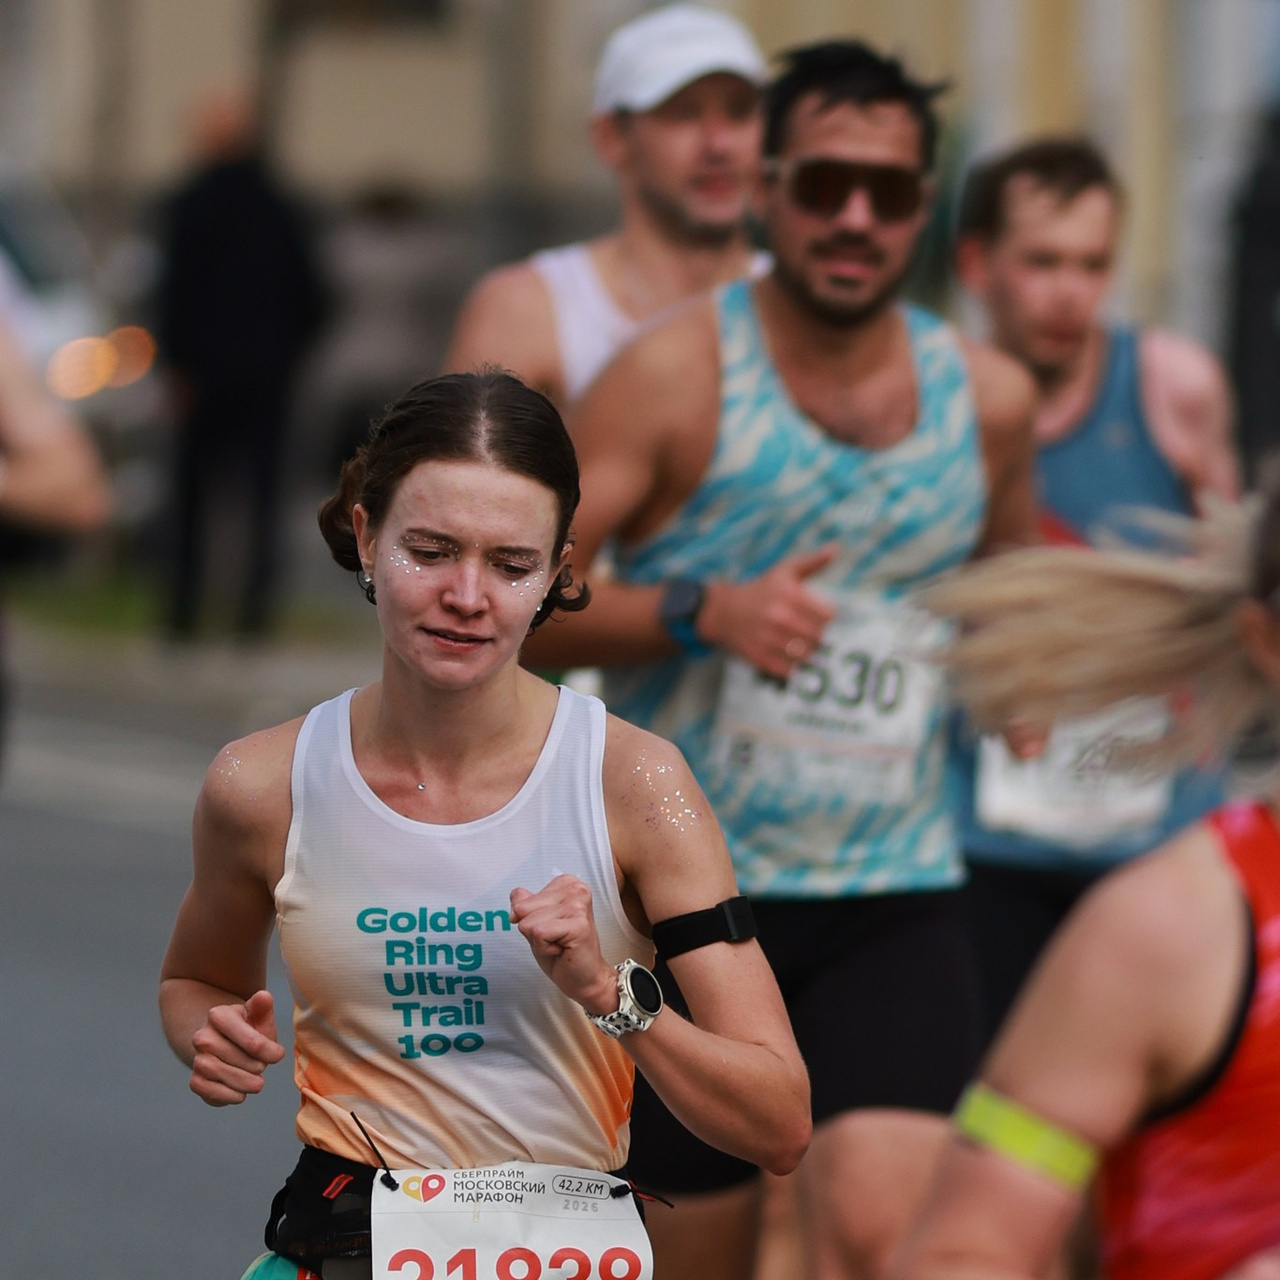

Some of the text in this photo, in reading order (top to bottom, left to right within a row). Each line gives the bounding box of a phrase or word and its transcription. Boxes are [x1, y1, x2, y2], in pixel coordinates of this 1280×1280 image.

[757, 646, 903, 715] 530
[356, 906, 511, 934] Golden
[385, 936, 483, 972] Ring
[383, 971, 489, 996] Ultra
[392, 998, 485, 1027] Trail
[397, 1031, 485, 1060] 100
[453, 1169, 525, 1179] СБЕРПРАЙМ
[558, 1178, 583, 1193] 42,2
[453, 1180, 546, 1194] МОСКОВСКИЙ
[453, 1192, 524, 1204] МАРАФОН
[562, 1198, 599, 1212] 2026
